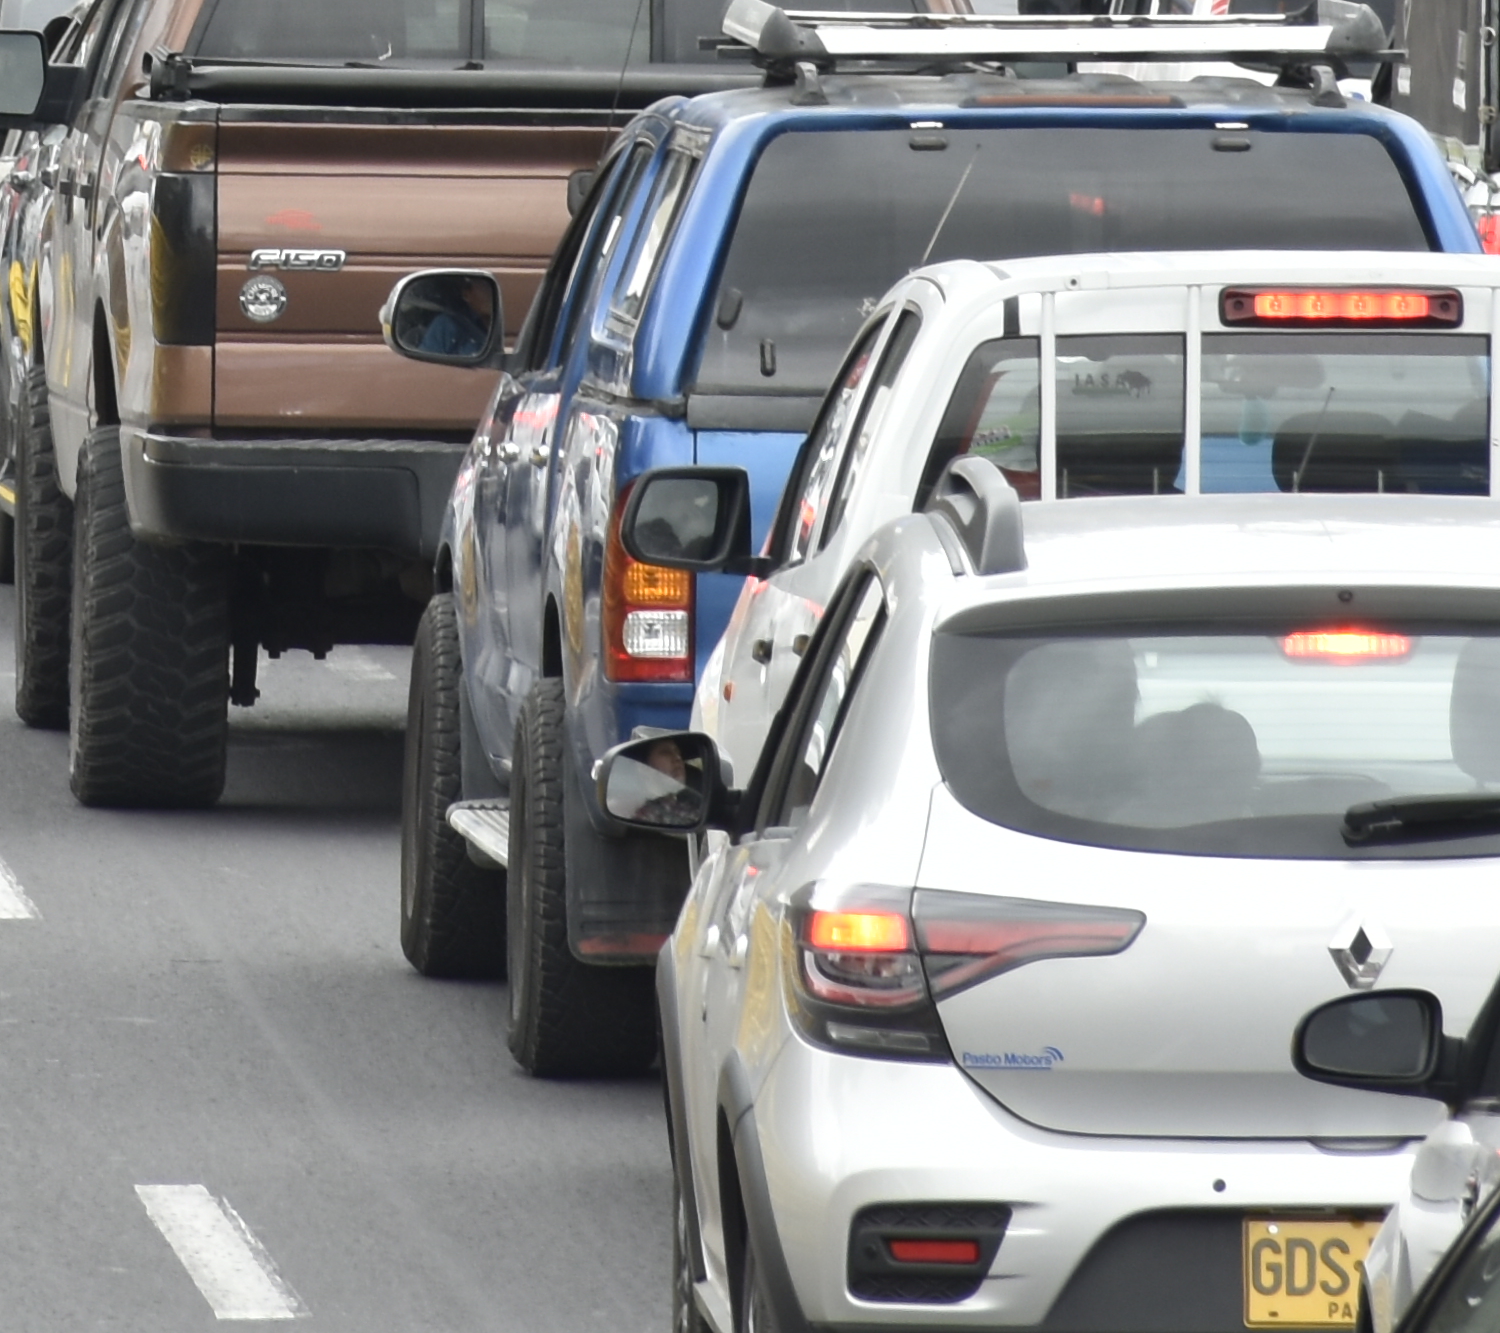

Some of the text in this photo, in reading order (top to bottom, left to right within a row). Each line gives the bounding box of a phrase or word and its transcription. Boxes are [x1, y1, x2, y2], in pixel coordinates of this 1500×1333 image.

[961, 1051, 1054, 1068] Pasto Motors
[1327, 1301, 1359, 1320] PA
